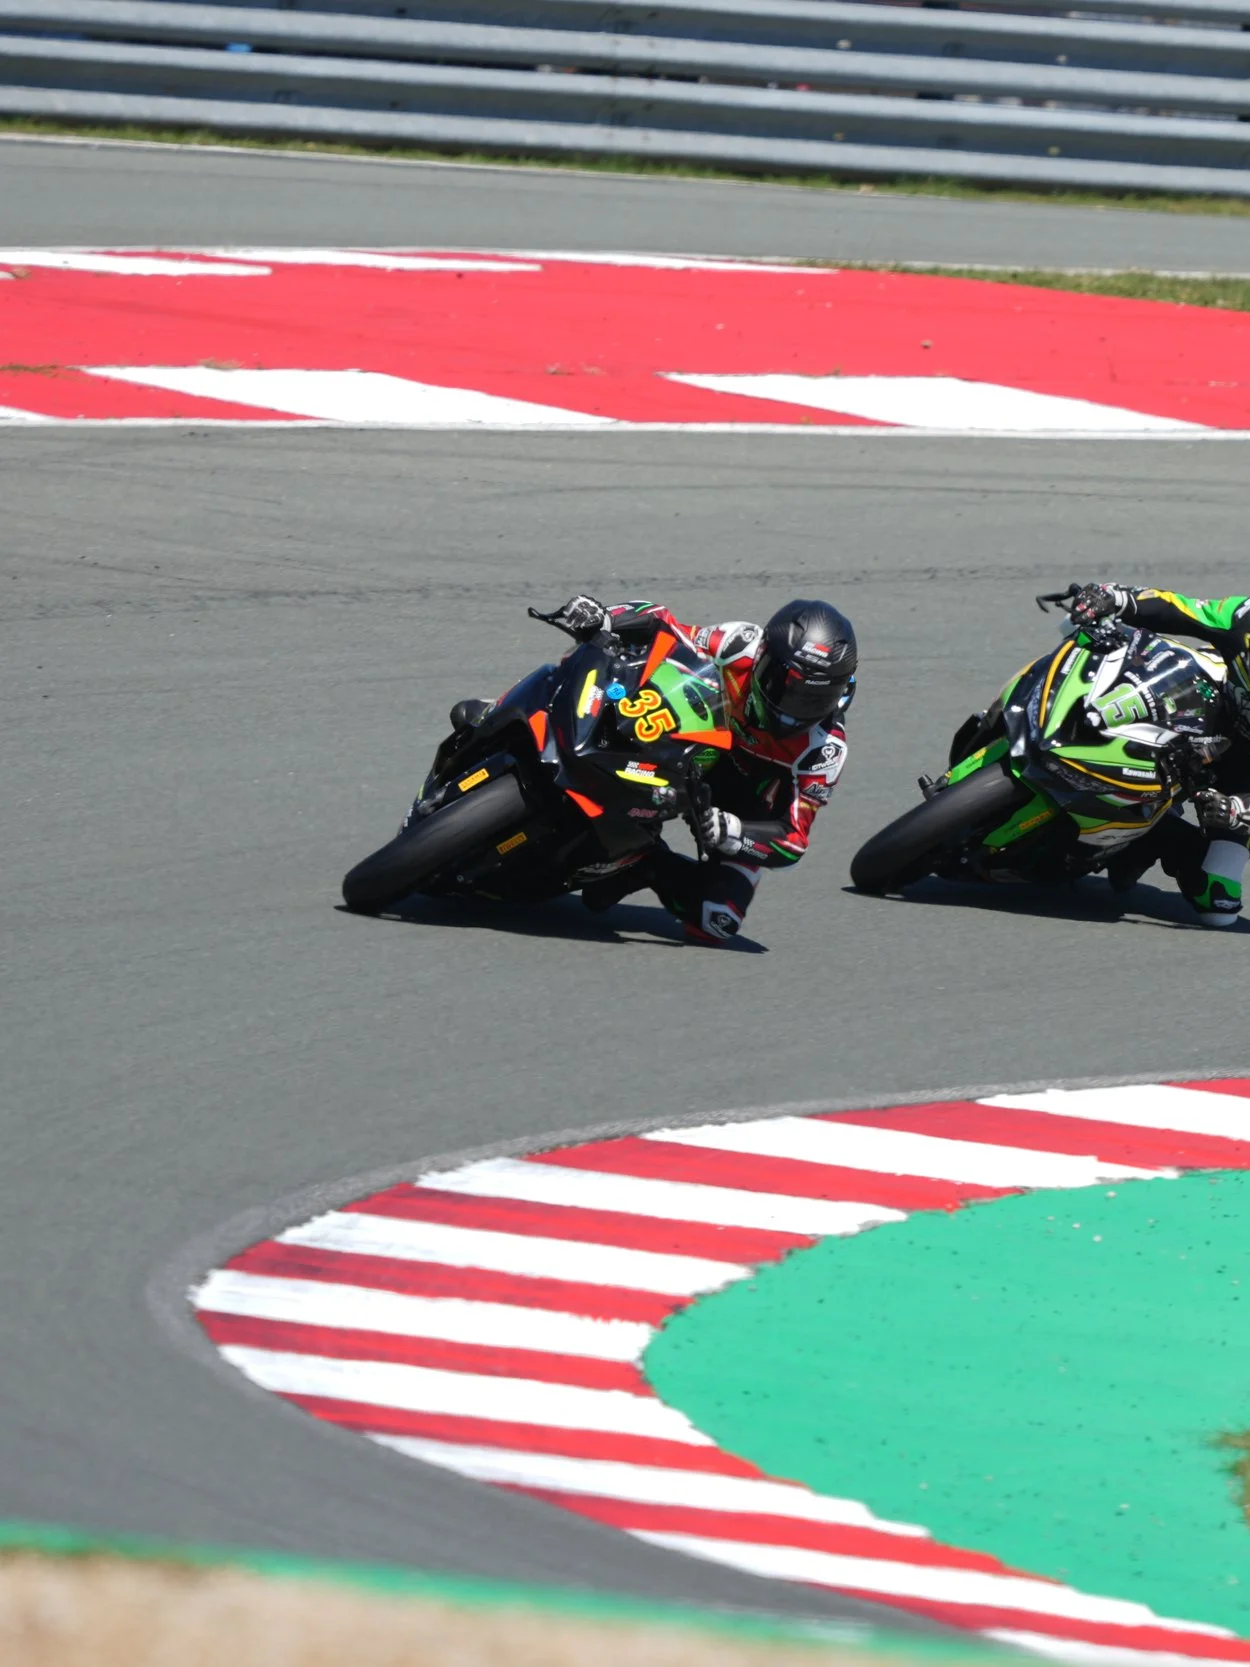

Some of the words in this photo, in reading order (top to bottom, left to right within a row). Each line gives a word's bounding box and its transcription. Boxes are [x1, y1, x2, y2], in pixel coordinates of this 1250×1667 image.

[618, 689, 677, 742] 35
[1091, 682, 1149, 729] 15
[1121, 767, 1157, 779] Kawasaki
